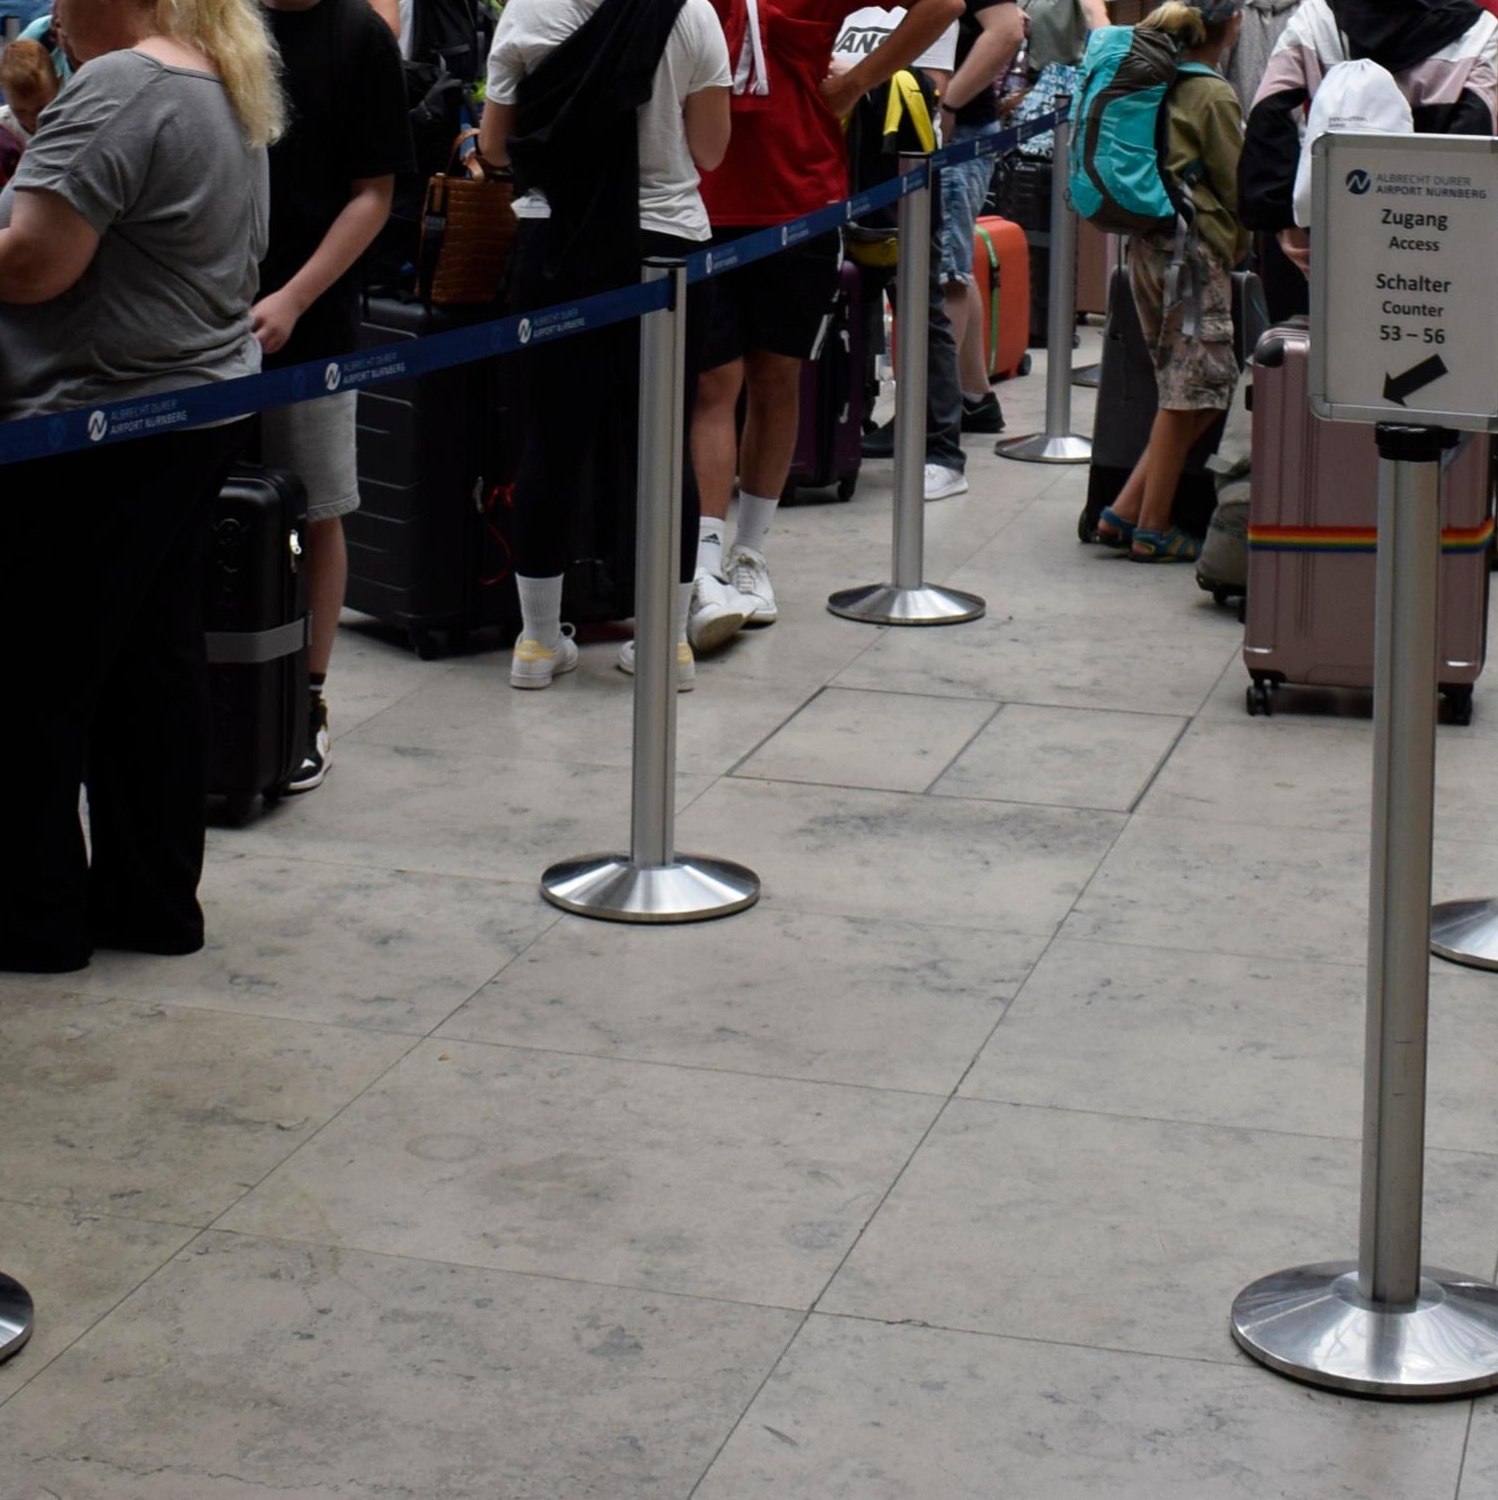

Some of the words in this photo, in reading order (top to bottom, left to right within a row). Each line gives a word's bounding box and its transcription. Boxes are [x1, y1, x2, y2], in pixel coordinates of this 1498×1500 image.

[1376, 173, 1430, 185] ALBRECHT
[1376, 185, 1423, 197] AIRPORT
[1381, 208, 1449, 231] Zugang
[1389, 236, 1440, 252] Access
[1376, 273, 1452, 293] Schalter
[1382, 300, 1444, 318] Counter
[1379, 324, 1402, 341] 53
[1423, 326, 1446, 345] 56
[110, 419, 144, 436] AIRPORT
